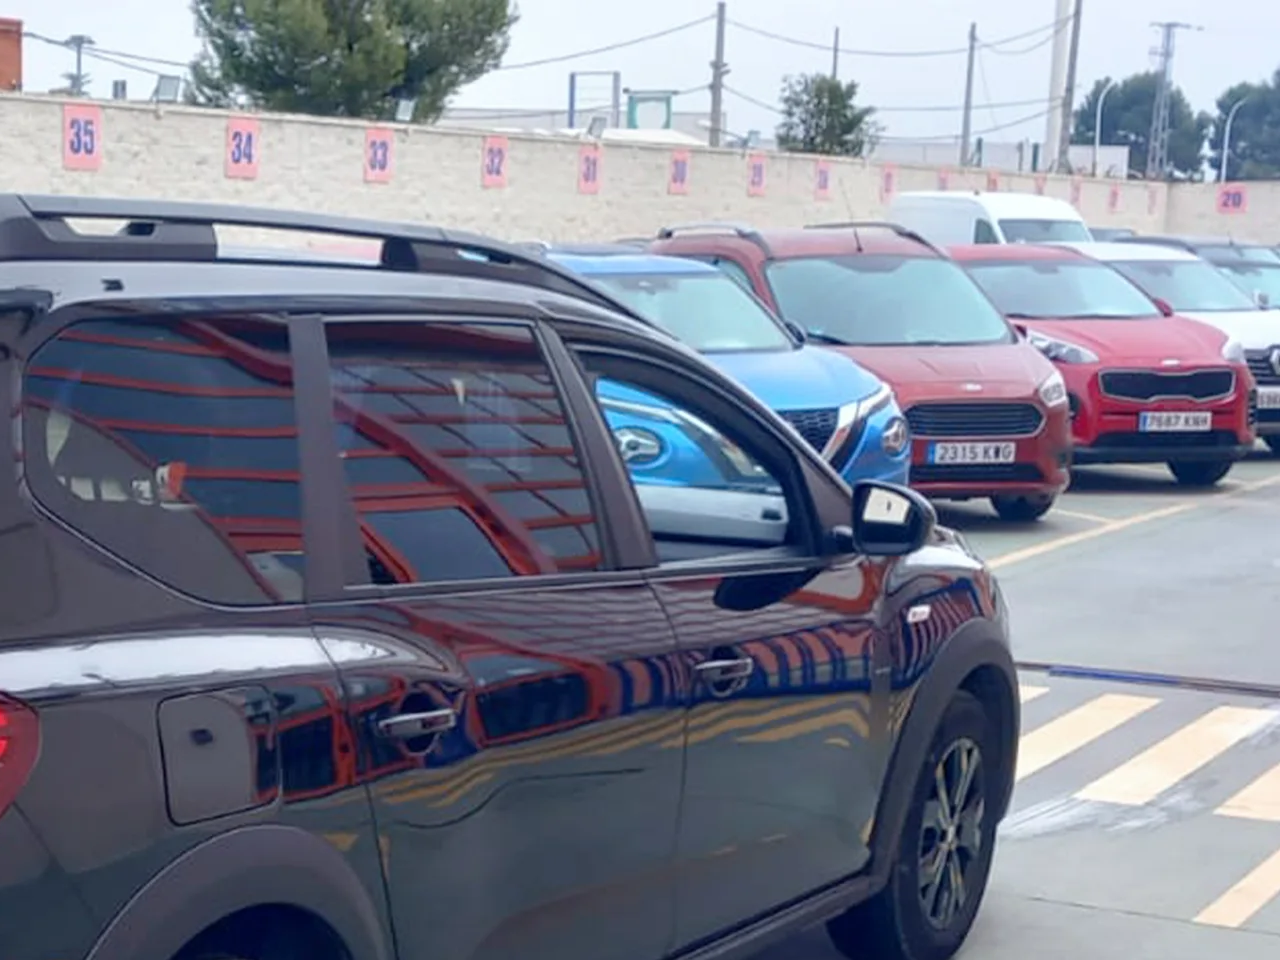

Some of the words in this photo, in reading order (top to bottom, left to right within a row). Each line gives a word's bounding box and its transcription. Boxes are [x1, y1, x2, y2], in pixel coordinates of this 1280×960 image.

[68, 118, 95, 156] 35
[230, 130, 254, 165] 34
[368, 139, 389, 171] 33
[485, 146, 505, 177] 32
[583, 155, 598, 183] 31
[1221, 191, 1243, 209] 20
[939, 444, 979, 461] 2315
